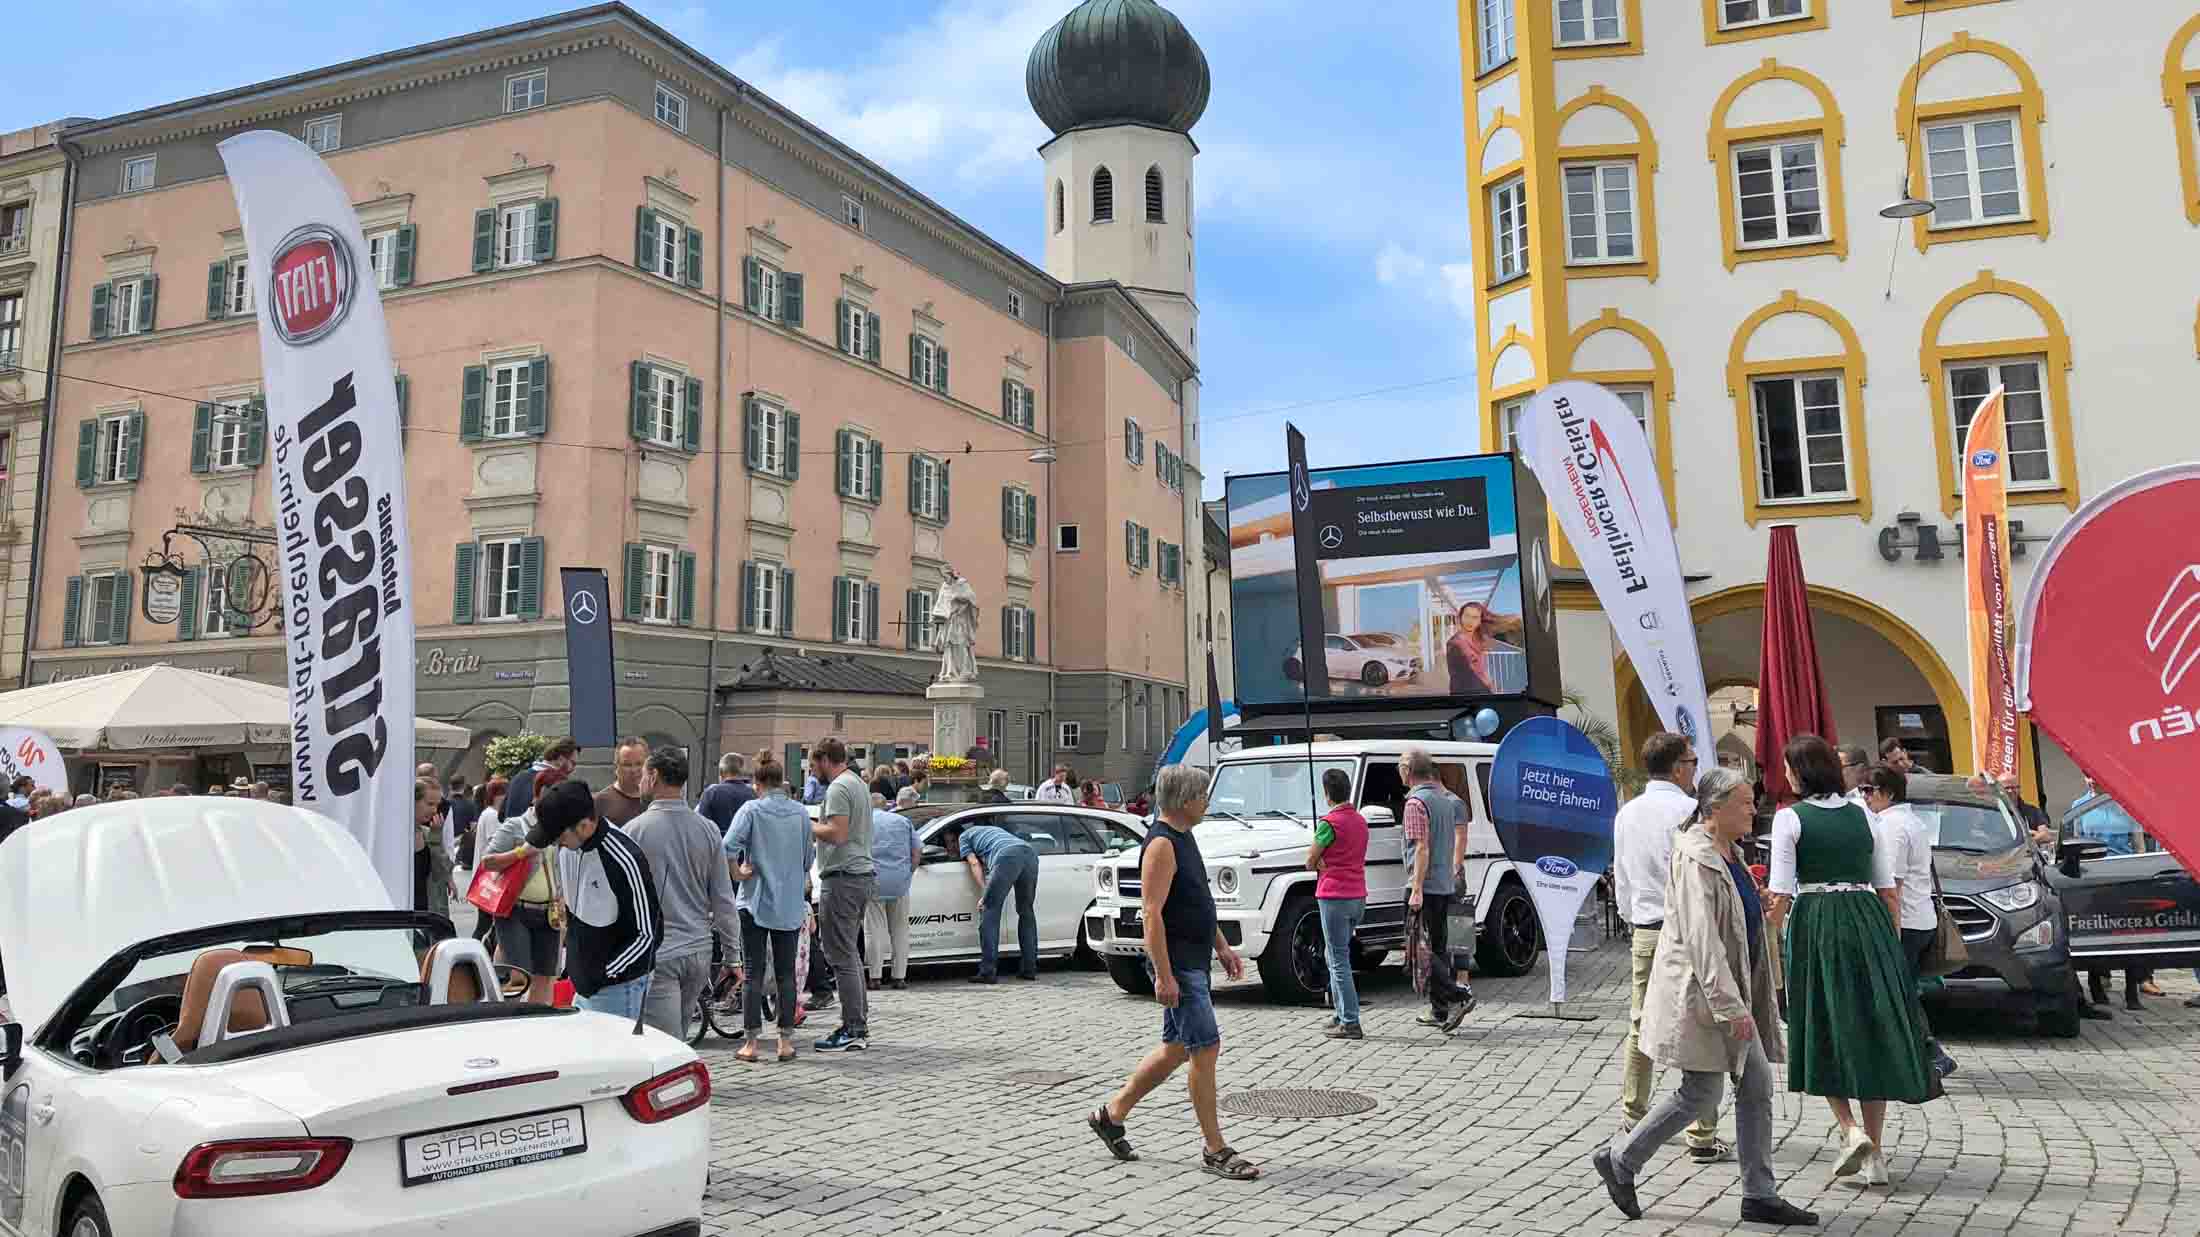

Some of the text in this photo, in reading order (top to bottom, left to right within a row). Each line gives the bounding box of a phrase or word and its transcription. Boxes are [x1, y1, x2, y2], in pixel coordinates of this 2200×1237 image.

[1357, 504, 1478, 524] Selbstbewusst wie Du.
[1994, 583, 2002, 609] von
[424, 648, 481, 675] Bräu
[1522, 767, 1575, 789] Jetzt hier
[1522, 785, 1601, 811] Probe fahren!
[1543, 864, 1570, 874] Ford
[422, 1117, 570, 1161] STRASSER
[421, 1135, 574, 1173] WWW.STRASSER-ROSENHEIM.DE
[431, 1165, 474, 1182] AUTOHAUS
[475, 1157, 514, 1174] STRASSER
[520, 1149, 564, 1164] ROSENHEIM
